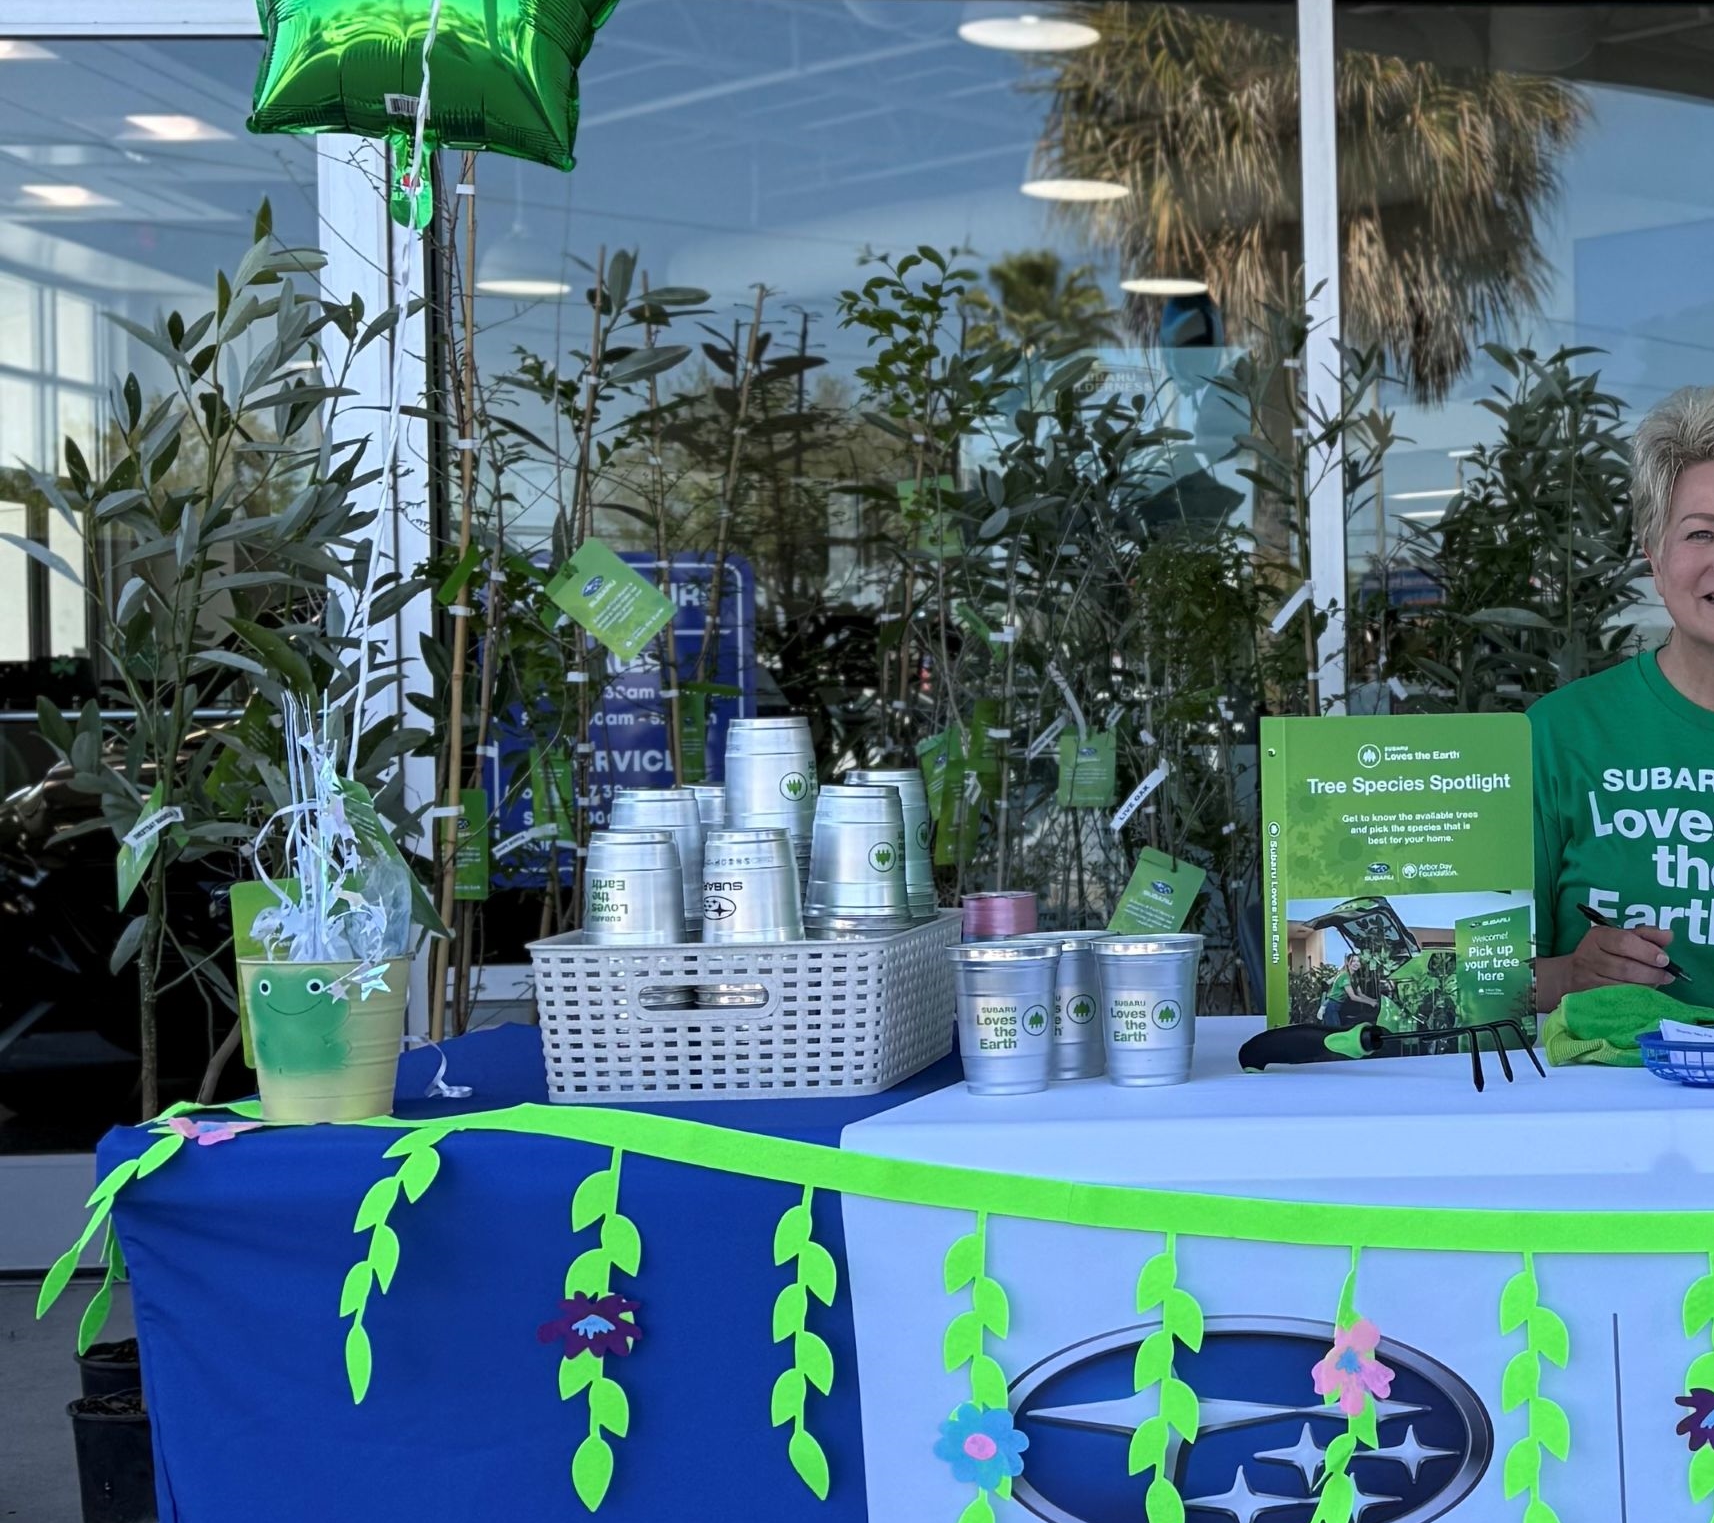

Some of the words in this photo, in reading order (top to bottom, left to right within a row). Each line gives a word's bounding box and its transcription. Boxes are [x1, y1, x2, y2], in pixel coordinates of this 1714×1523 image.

[1384, 752, 1413, 761] Loves
[1414, 751, 1431, 760] the
[1433, 750, 1460, 759] Earth
[1307, 779, 1347, 794] Tree
[1352, 776, 1425, 795] Species
[1430, 773, 1511, 793] Spotlight
[1119, 800, 1136, 821] LIVE
[1134, 784, 1150, 802] OAK
[1342, 814, 1358, 823] Get
[1360, 814, 1370, 822] to
[1372, 813, 1397, 822] know
[1399, 812, 1413, 821] the
[1415, 811, 1454, 820] available
[1456, 811, 1478, 819] trees
[1350, 825, 1367, 834] and
[1369, 824, 1388, 835] pick
[1391, 824, 1405, 832] the
[1407, 823, 1441, 833] species
[1443, 822, 1461, 831] that
[1463, 822, 1471, 830] is
[1368, 836, 1387, 845] best
[1389, 835, 1402, 844] for
[1405, 836, 1424, 845] your
[1426, 834, 1454, 843] home.
[1270, 840, 1278, 879] Subaru
[1418, 863, 1438, 871] Arbor
[1439, 863, 1453, 871] Day
[592, 879, 625, 891] Earth
[704, 881, 743, 891] SUBAR
[592, 891, 610, 902] the
[1271, 881, 1279, 913] Loves
[591, 903, 628, 915] Loves
[1271, 915, 1279, 932] the
[1272, 934, 1280, 964] Earth
[1468, 945, 1493, 958] Pick
[1497, 945, 1513, 957] up
[1465, 960, 1489, 971] your
[1493, 957, 1519, 968] tree
[1477, 971, 1505, 981] here
[1114, 999, 1146, 1007] SUBARU
[981, 1006, 1017, 1014] SUBARU
[1110, 1008, 1147, 1019] Loves
[976, 1015, 1017, 1026] Loves
[1125, 1019, 1147, 1030] the
[994, 1026, 1018, 1037] the
[1113, 1031, 1147, 1042] Earth
[980, 1038, 1018, 1050] Earth
